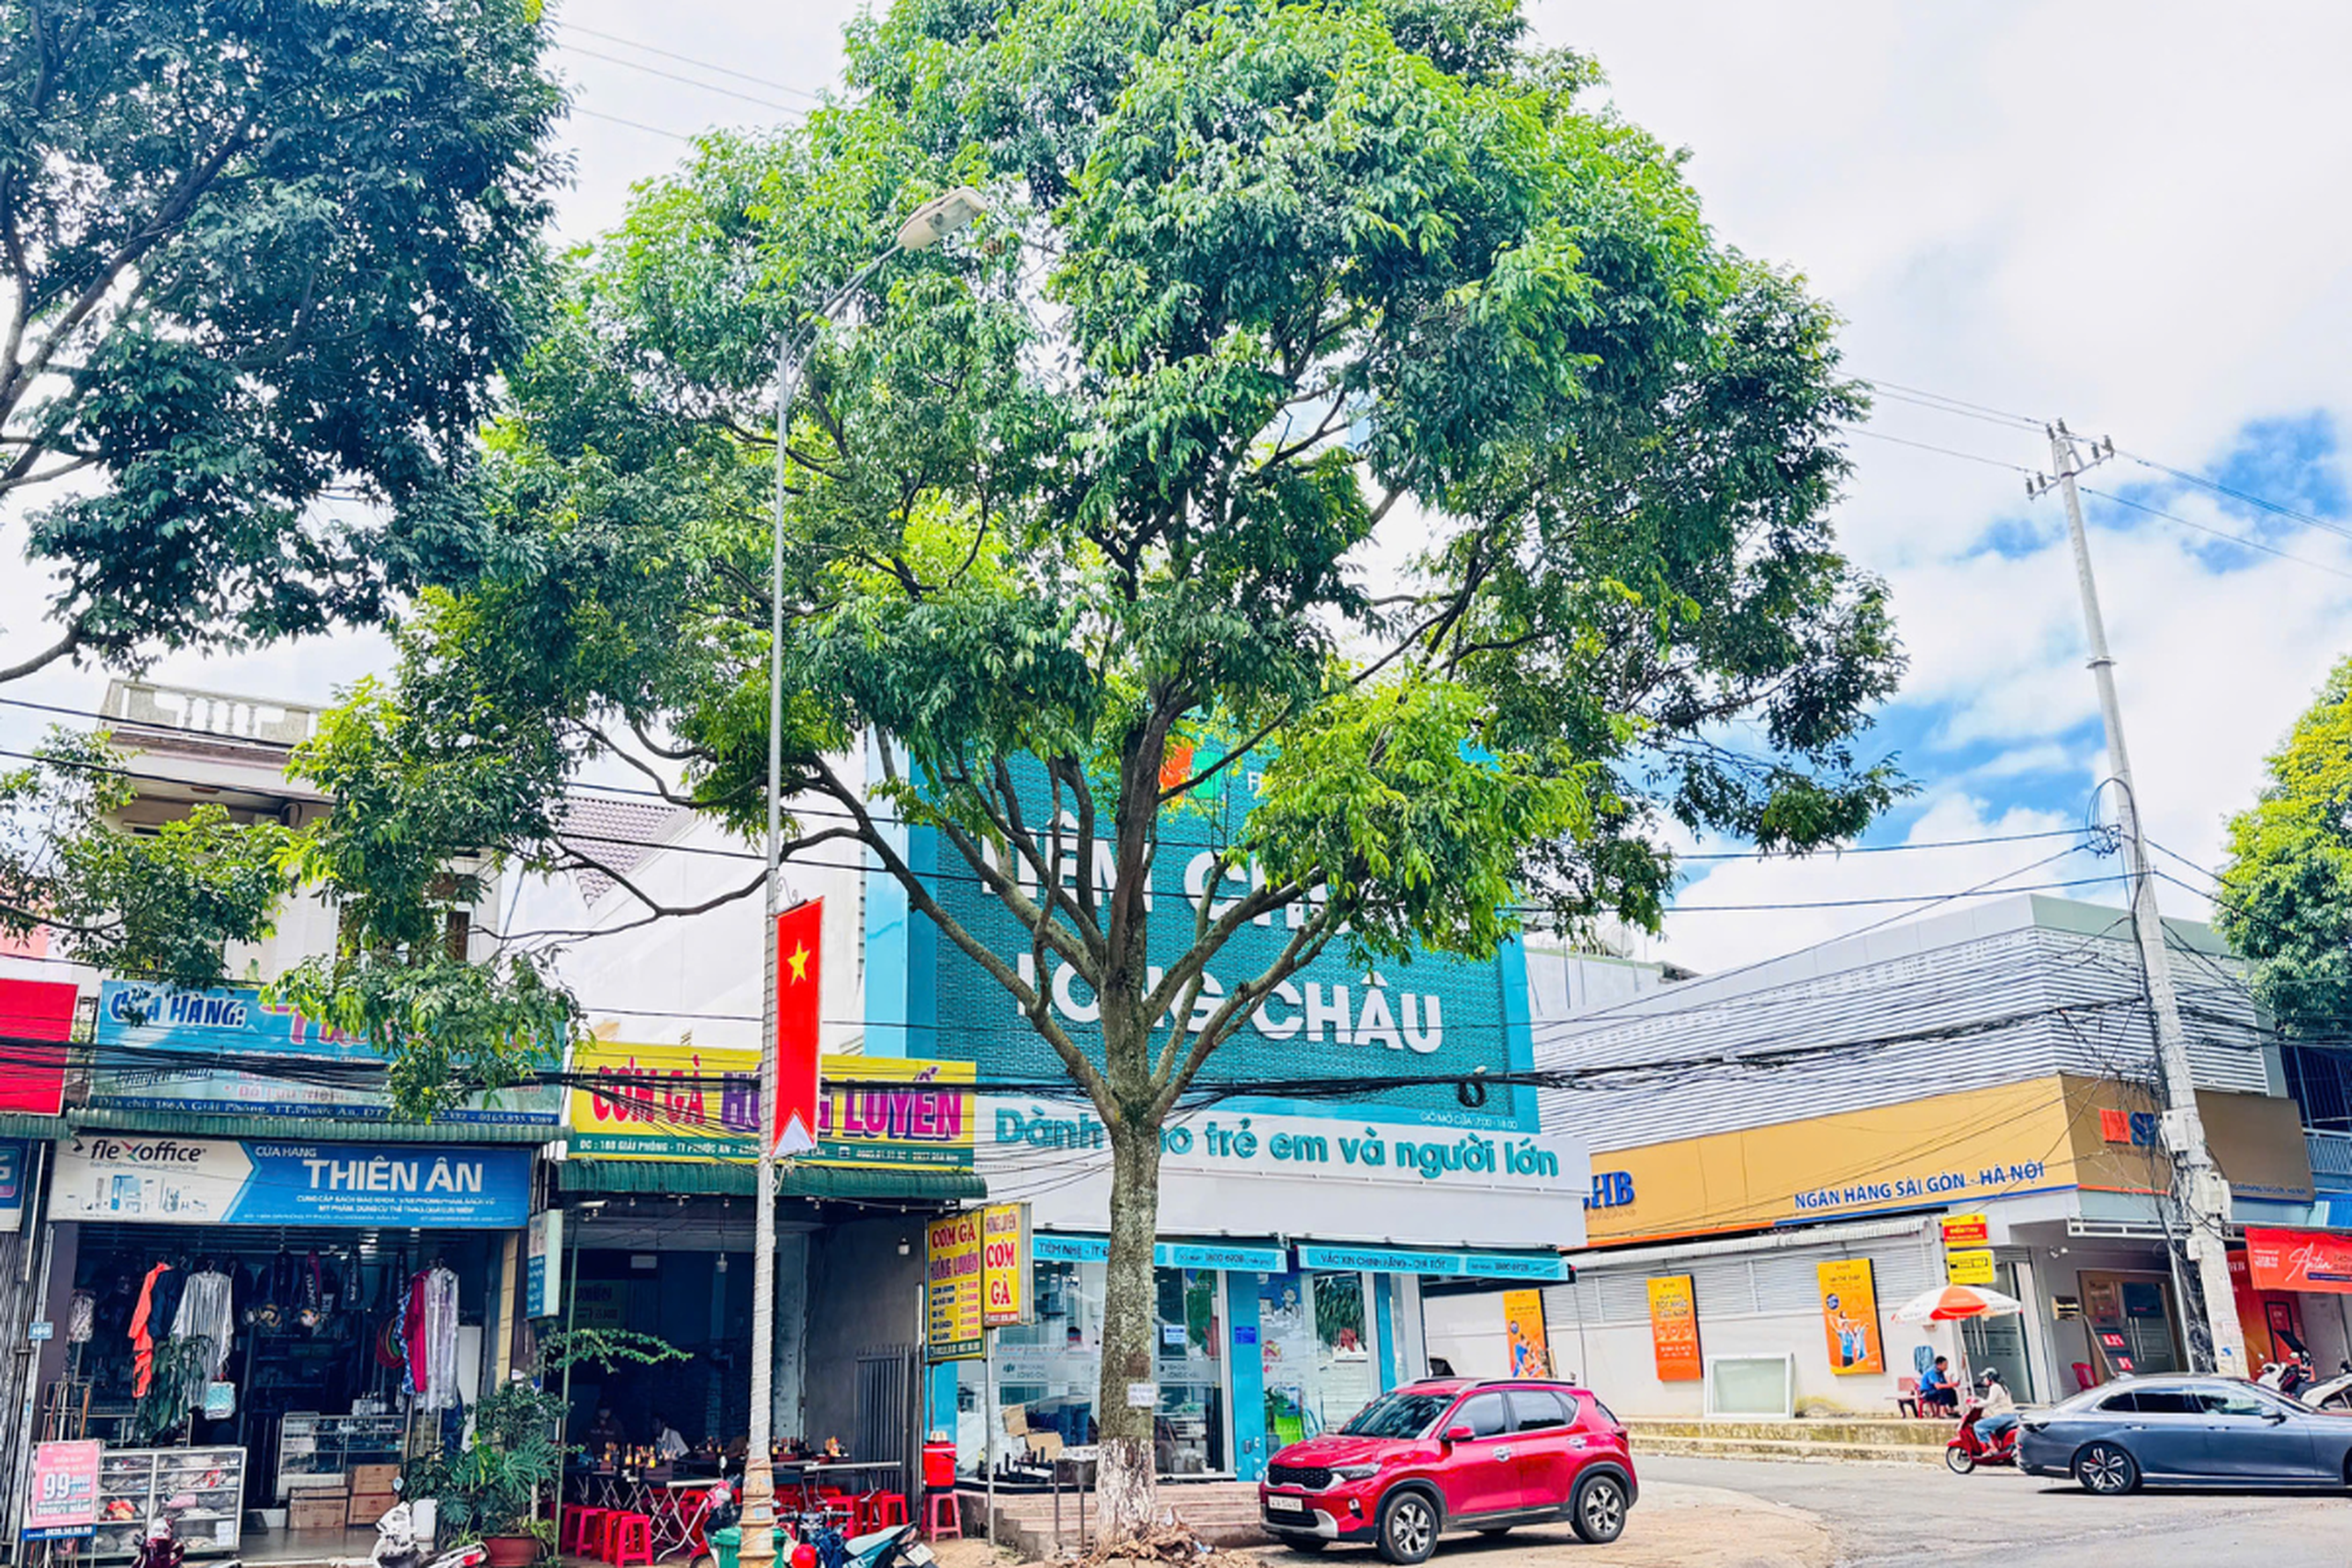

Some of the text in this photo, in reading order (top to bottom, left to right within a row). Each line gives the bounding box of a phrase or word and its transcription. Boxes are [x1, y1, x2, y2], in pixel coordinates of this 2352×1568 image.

[1250, 971, 1443, 1054] CHÂU
[995, 1106, 1104, 1149] Dành
[1204, 1117, 1259, 1159] trẻ
[1269, 1132, 1329, 1162] em
[1339, 1126, 1386, 1167] và
[1395, 1133, 1497, 1179] người
[1503, 1136, 1560, 1178] lớn
[302, 1155, 483, 1192] THIÊN ÂN
[1582, 1170, 1635, 1210] HB
[1794, 1185, 1841, 1209] NGÂN
[1844, 1181, 1891, 1204] HÀNG
[1895, 1177, 1923, 1198] SÀI
[1926, 1170, 1966, 1193] GÒN
[1979, 1163, 2006, 1186] HÀ
[2009, 1158, 2045, 1185] NỘI
[958, 1218, 977, 1245] GÀ
[985, 1238, 1016, 1269] CƠM
[990, 1271, 1012, 1306] GÀ
